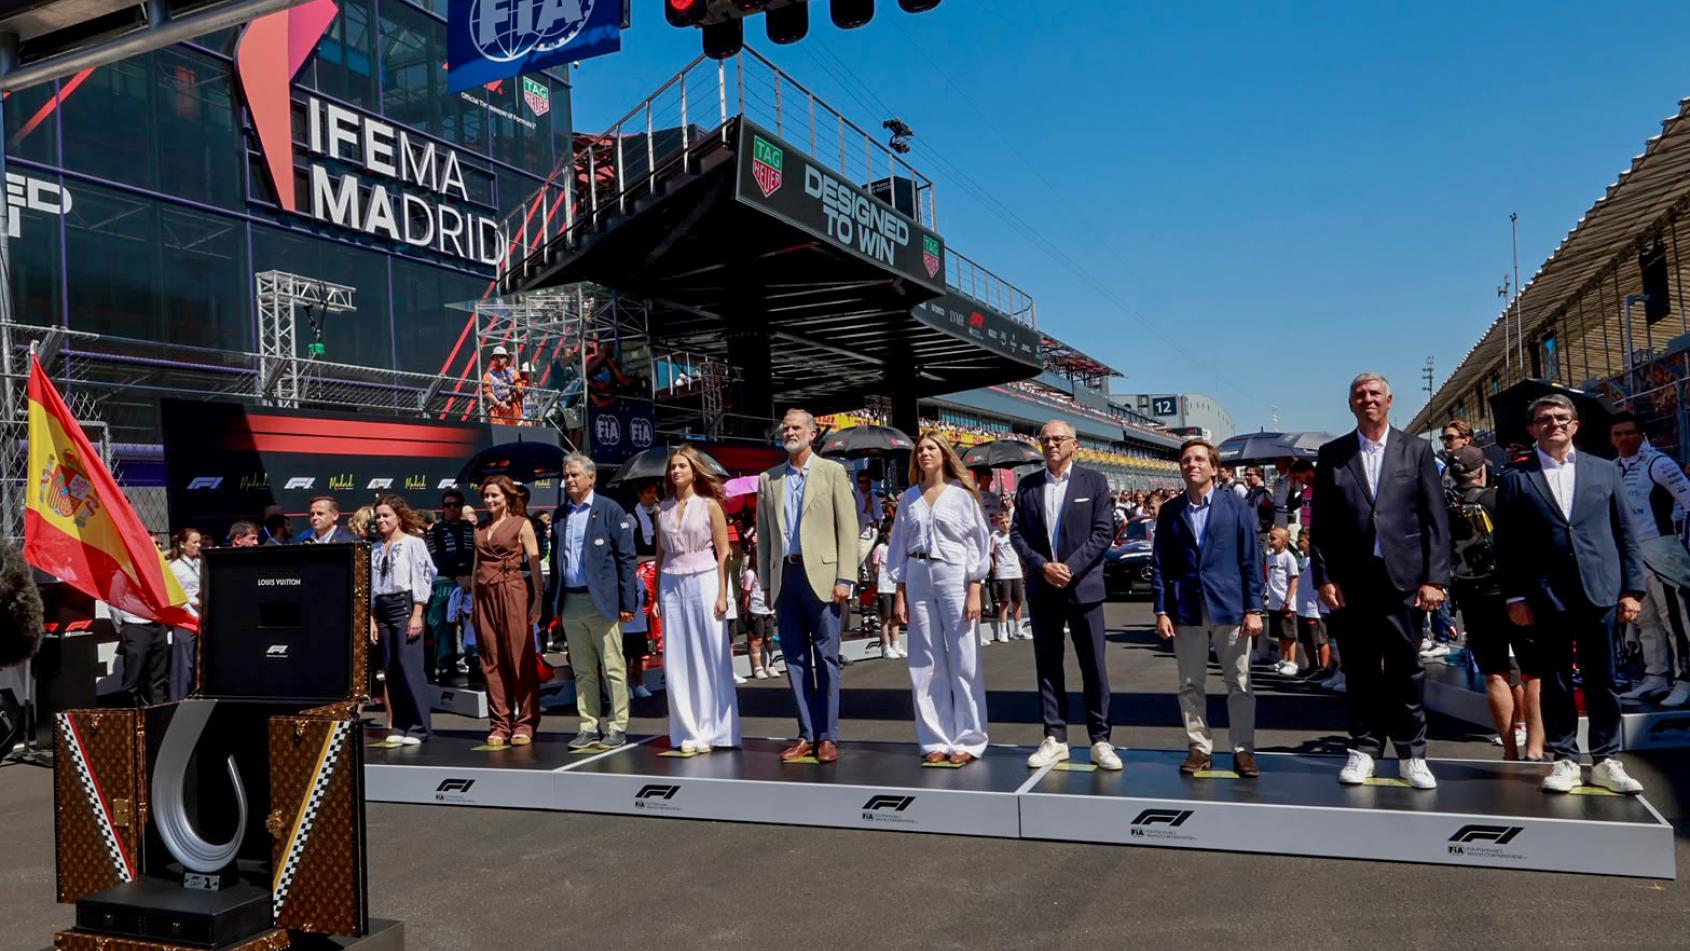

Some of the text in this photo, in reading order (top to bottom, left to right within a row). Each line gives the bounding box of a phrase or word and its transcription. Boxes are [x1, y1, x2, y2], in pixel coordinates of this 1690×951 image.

[525, 79, 547, 98] TAG
[308, 96, 469, 202] IFEMA
[756, 140, 781, 169] TAG
[753, 160, 781, 194] HEUER
[311, 163, 505, 266] MADRID
[804, 163, 909, 247] DESIGNED
[823, 204, 895, 267] TO WIN
[1155, 401, 1171, 413] 12
[186, 476, 224, 490] F1
[283, 477, 316, 489] F1
[329, 473, 354, 490] Madrid
[366, 478, 394, 489] F1
[405, 474, 427, 490] Madrid
[257, 578, 301, 586] LOUIS VUITTON
[266, 644, 289, 654] F1
[436, 778, 476, 793] F1
[635, 784, 681, 800] F1
[862, 795, 916, 811] F1
[1130, 808, 1195, 827] F1
[1448, 824, 1524, 845] F1
[204, 877, 211, 889] 1
